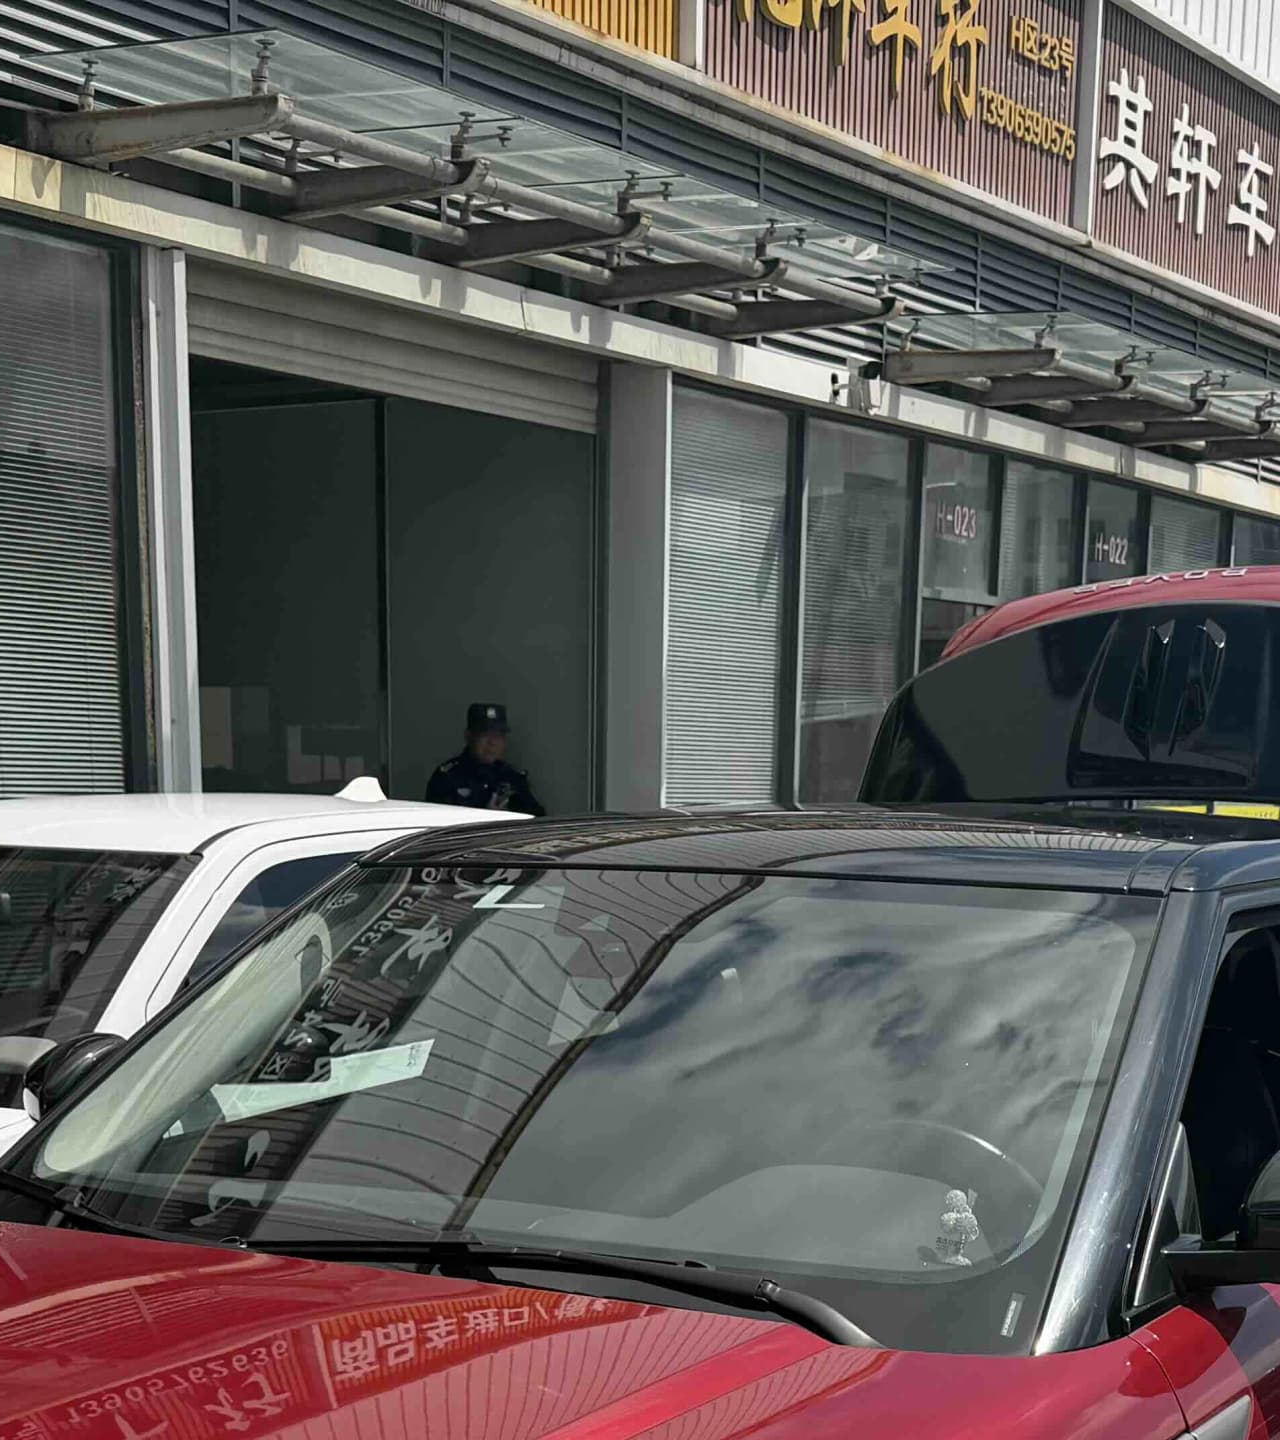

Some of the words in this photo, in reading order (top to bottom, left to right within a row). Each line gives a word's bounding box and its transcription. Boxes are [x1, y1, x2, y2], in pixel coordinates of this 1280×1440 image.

[1011, 16, 1074, 78] H区23号
[979, 87, 1076, 161] 13906590575
[936, 501, 977, 539] H-023
[1094, 532, 1129, 565] H-022
